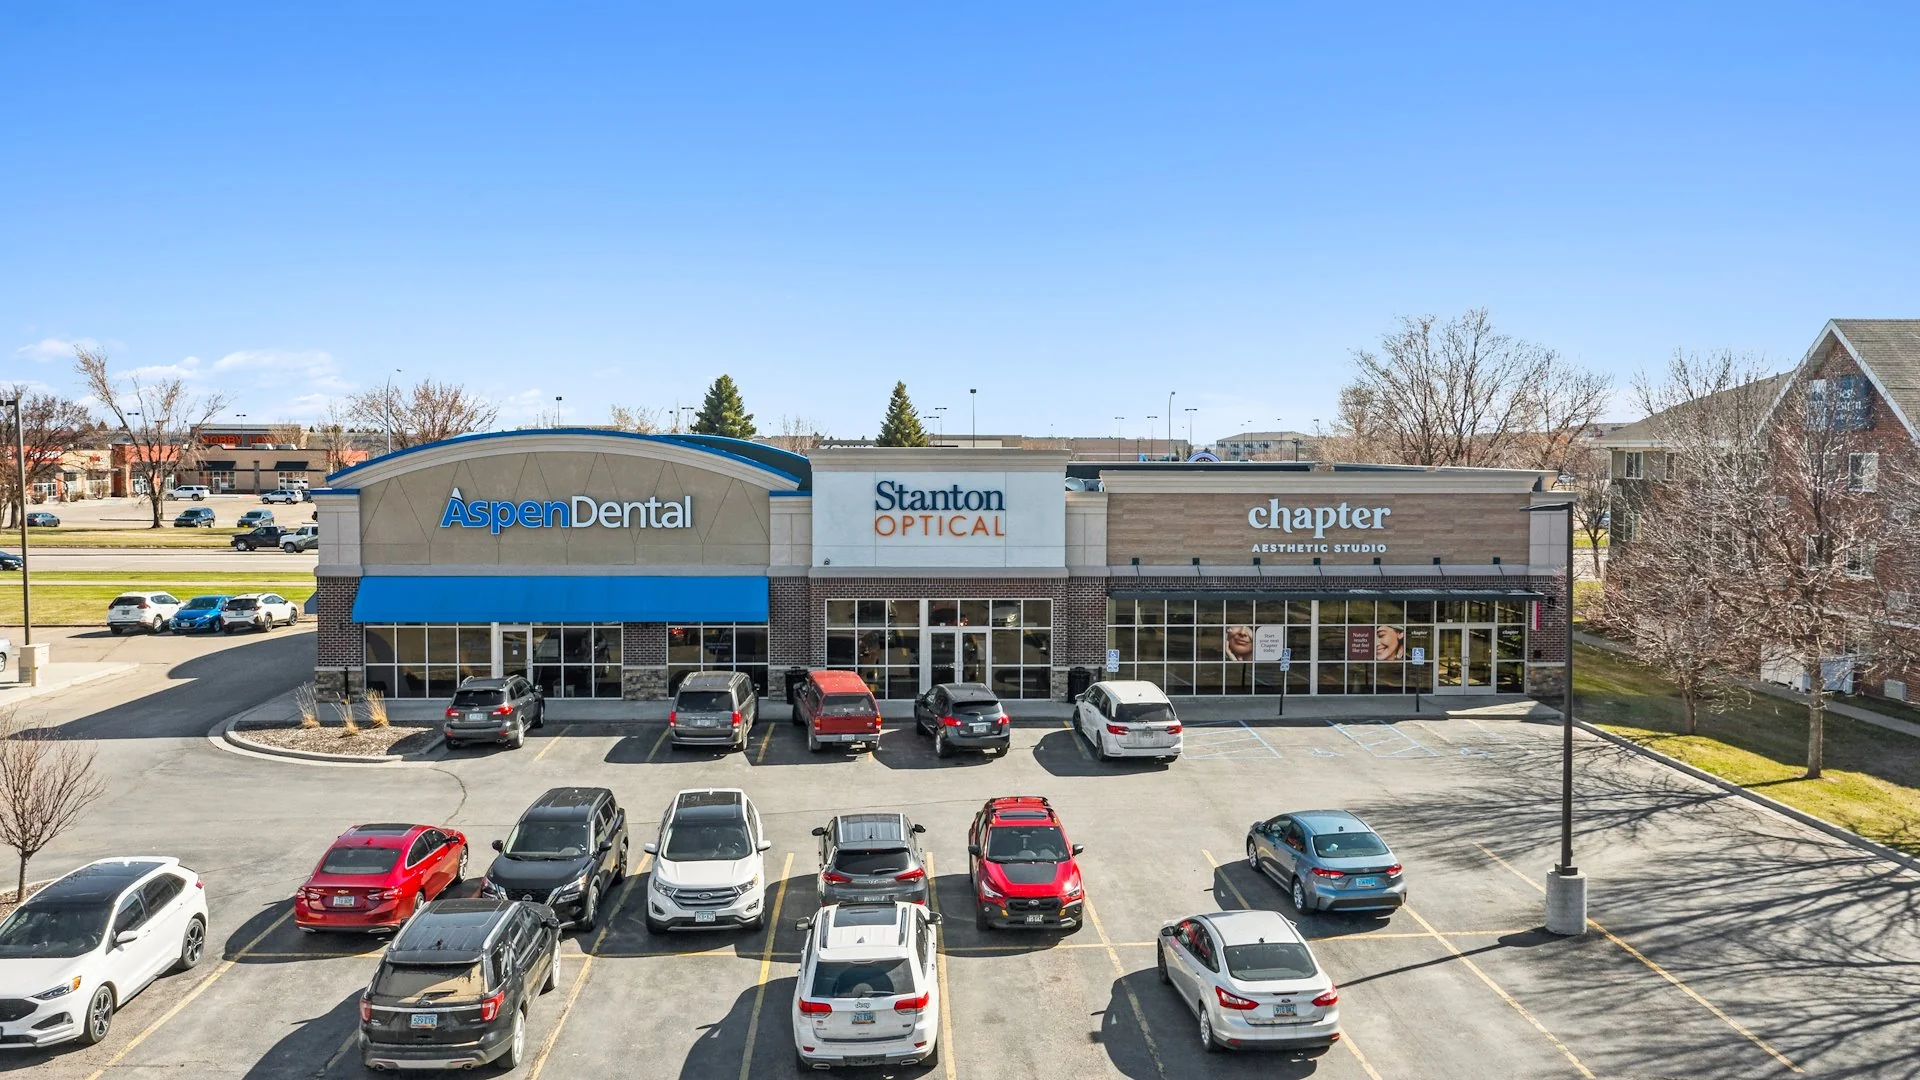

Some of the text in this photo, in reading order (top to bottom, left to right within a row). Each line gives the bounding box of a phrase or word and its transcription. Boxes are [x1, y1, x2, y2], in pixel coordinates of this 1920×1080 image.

[875, 480, 1006, 511] Stanton
[874, 515, 1006, 537] OPTICAL
[1247, 498, 1392, 539] chapter
[1251, 543, 1388, 554] AESTHETIC STUDIO
